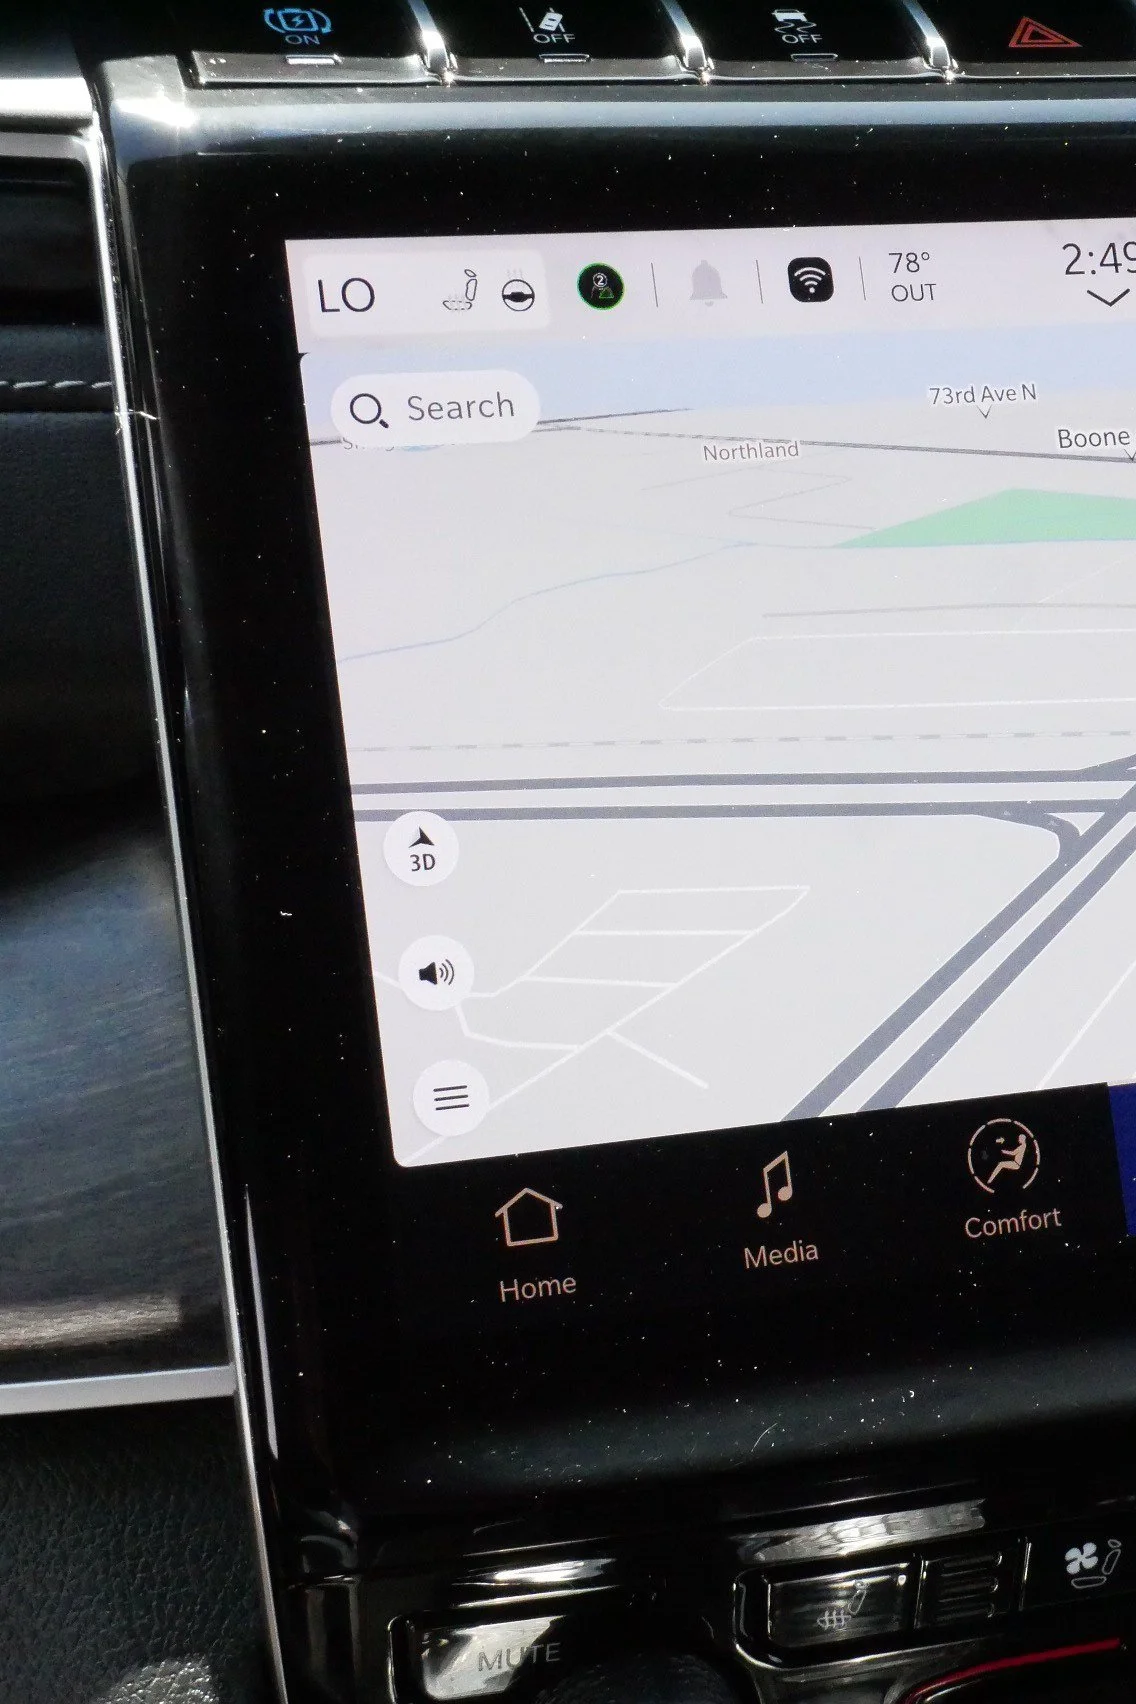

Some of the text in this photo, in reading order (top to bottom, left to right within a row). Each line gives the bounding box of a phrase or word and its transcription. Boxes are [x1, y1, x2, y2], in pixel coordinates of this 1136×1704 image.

[285, 34, 320, 46] ON
[533, 33, 576, 45] OFF
[781, 33, 823, 45] OFF
[888, 251, 931, 275] 78°
[317, 277, 375, 313] LO
[890, 283, 937, 303] OUT
[929, 383, 1037, 405] 73rd Ave N
[407, 391, 515, 423] Search
[1057, 427, 1131, 450] Boone
[703, 440, 799, 461] Northland
[409, 853, 436, 871] 3D
[964, 1207, 1062, 1240] Comfort
[743, 1239, 820, 1270] Media
[500, 1272, 577, 1303] Home
[477, 1642, 562, 1672] MUTE
